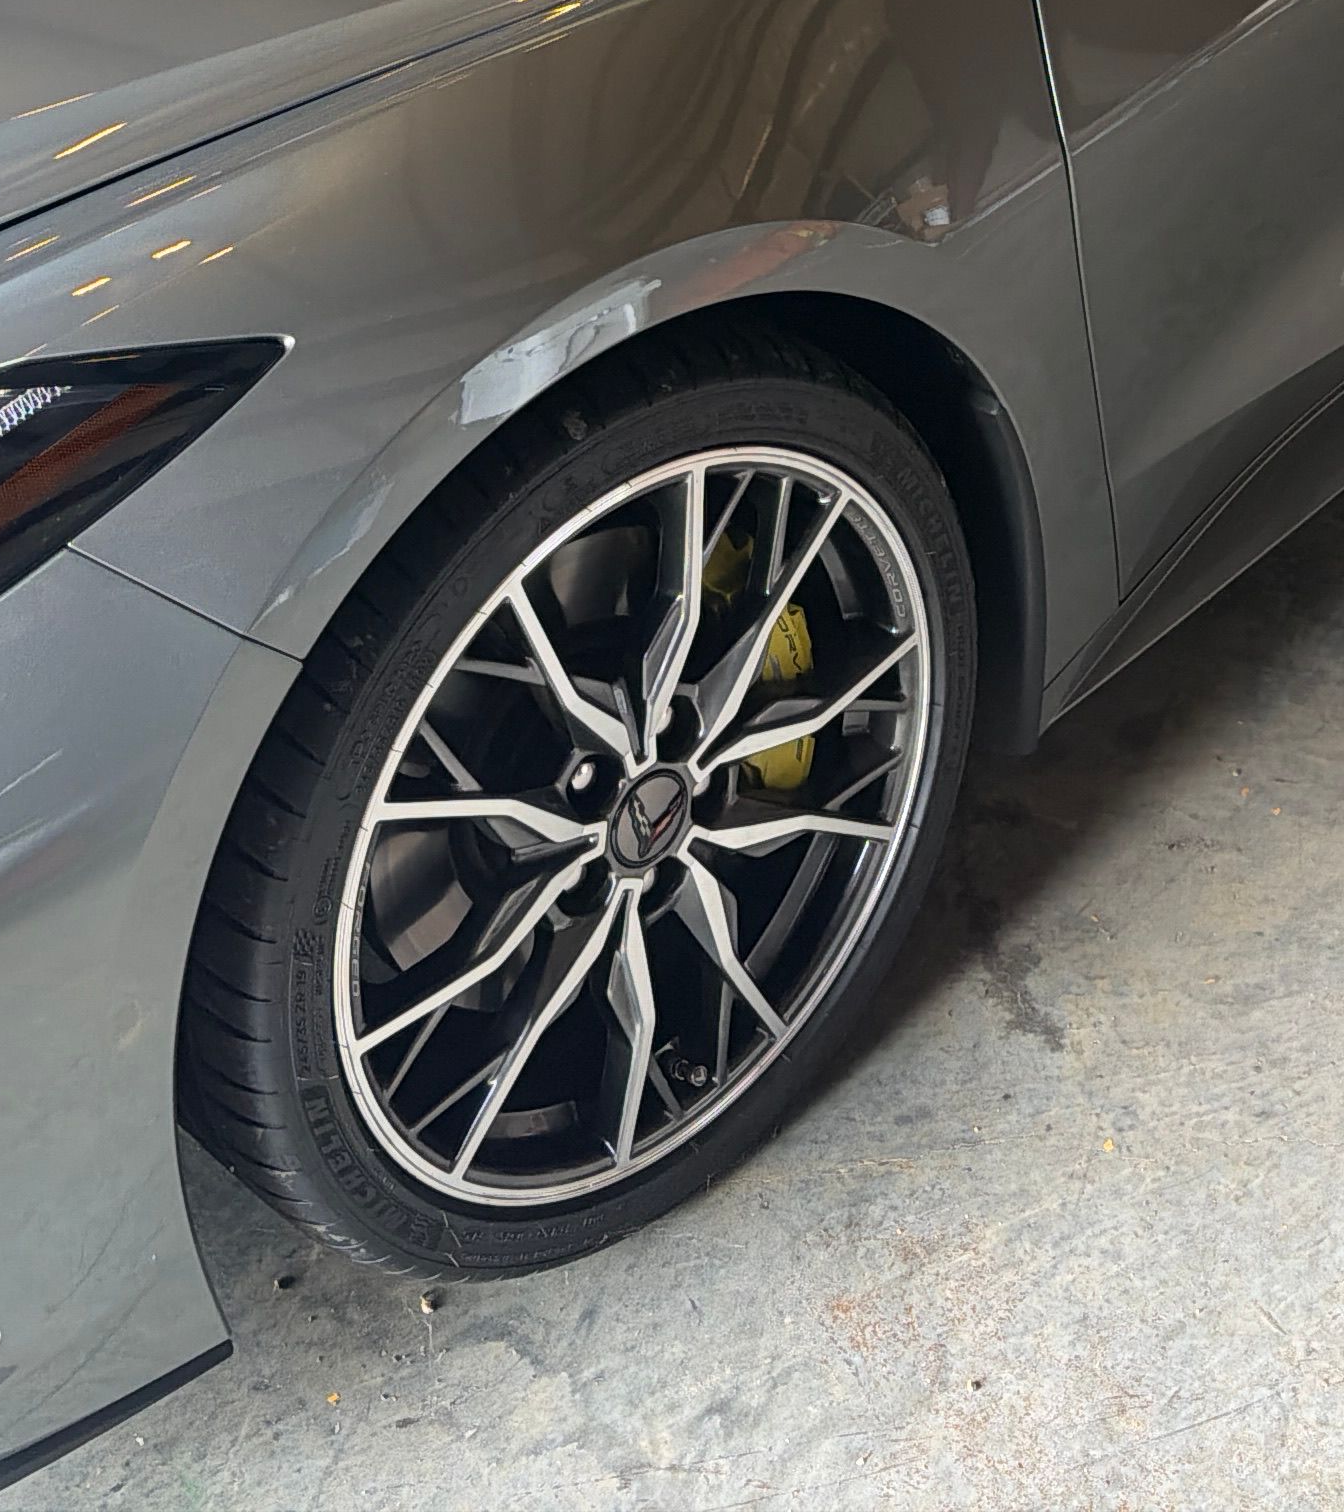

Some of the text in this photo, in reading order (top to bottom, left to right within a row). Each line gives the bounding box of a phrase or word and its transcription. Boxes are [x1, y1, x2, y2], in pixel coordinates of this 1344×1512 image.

[851, 512, 906, 619] CORVETTE
[895, 467, 963, 603] MICHELIN
[351, 860, 371, 998] FORGED
[304, 1095, 408, 1231] MICHELIN
